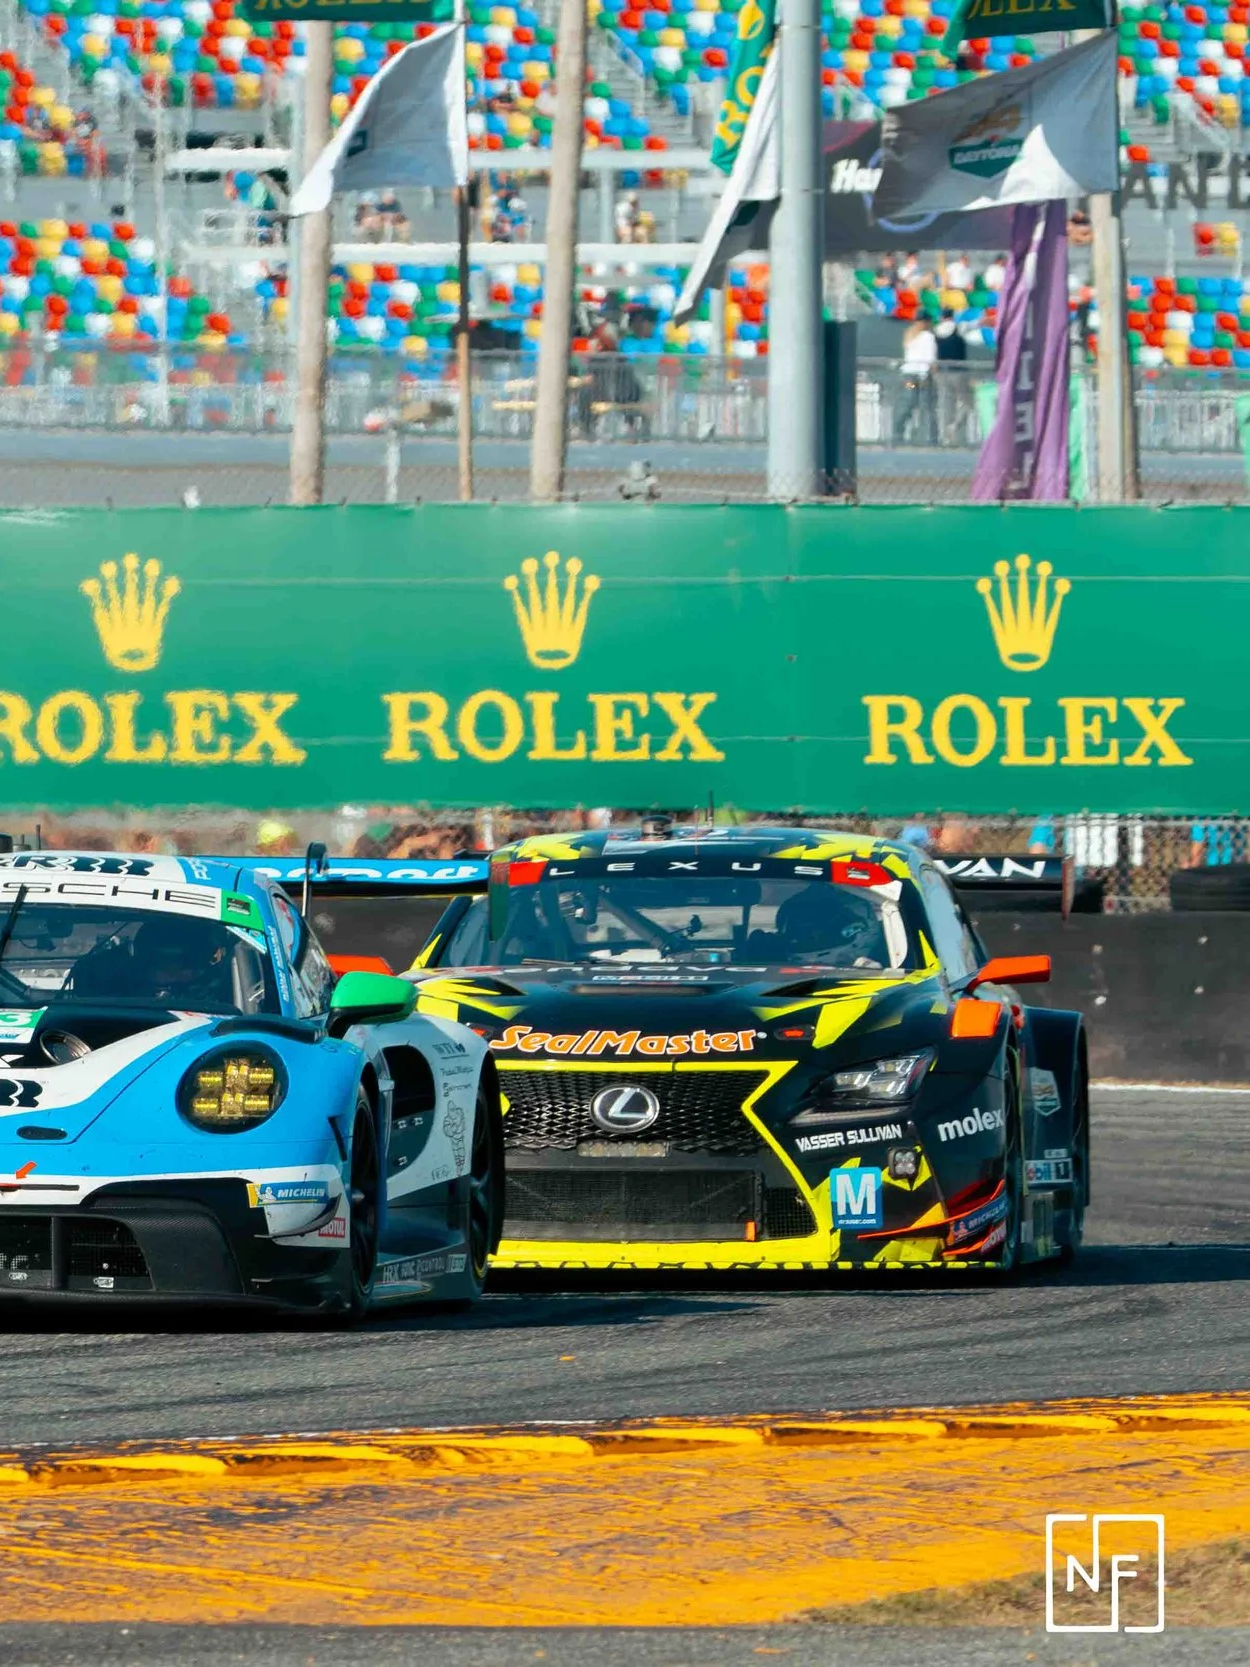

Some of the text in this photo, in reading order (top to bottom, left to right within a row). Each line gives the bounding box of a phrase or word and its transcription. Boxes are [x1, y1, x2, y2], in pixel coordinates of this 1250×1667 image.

[382, 690, 724, 762] ROLEX
[863, 694, 1193, 766] ROLEX
[550, 861, 823, 877] LEXUS
[933, 857, 1046, 878] VAN
[489, 1025, 756, 1055] SealMaster
[796, 1124, 902, 1153] VASSER SULLIVAN
[937, 1107, 1005, 1142] molex
[277, 1188, 325, 1198] MICHELIN
[836, 1173, 876, 1216] M
